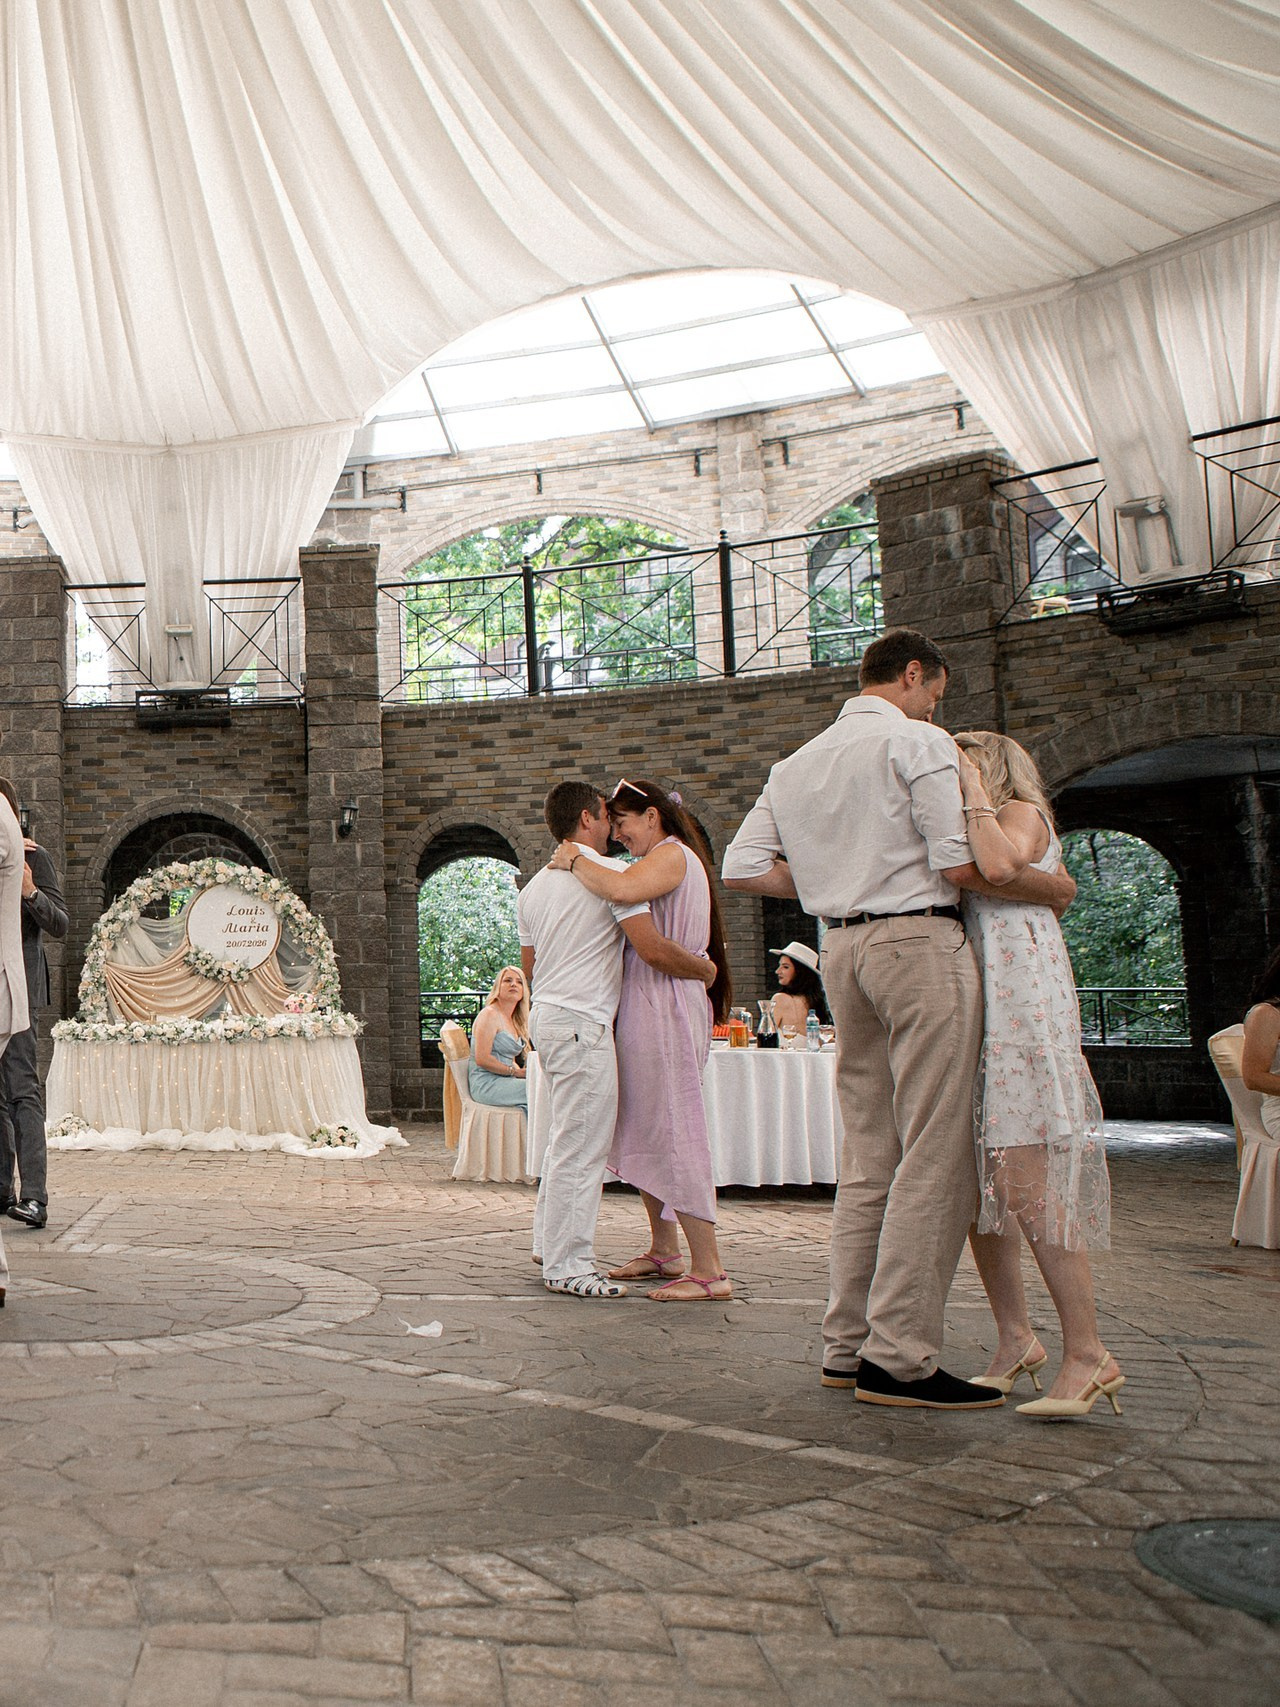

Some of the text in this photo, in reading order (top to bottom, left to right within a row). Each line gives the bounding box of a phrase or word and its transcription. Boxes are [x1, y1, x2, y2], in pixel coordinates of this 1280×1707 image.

[226, 904, 265, 916] Louis
[250, 916, 257, 924] &
[221, 922, 269, 933] Maria
